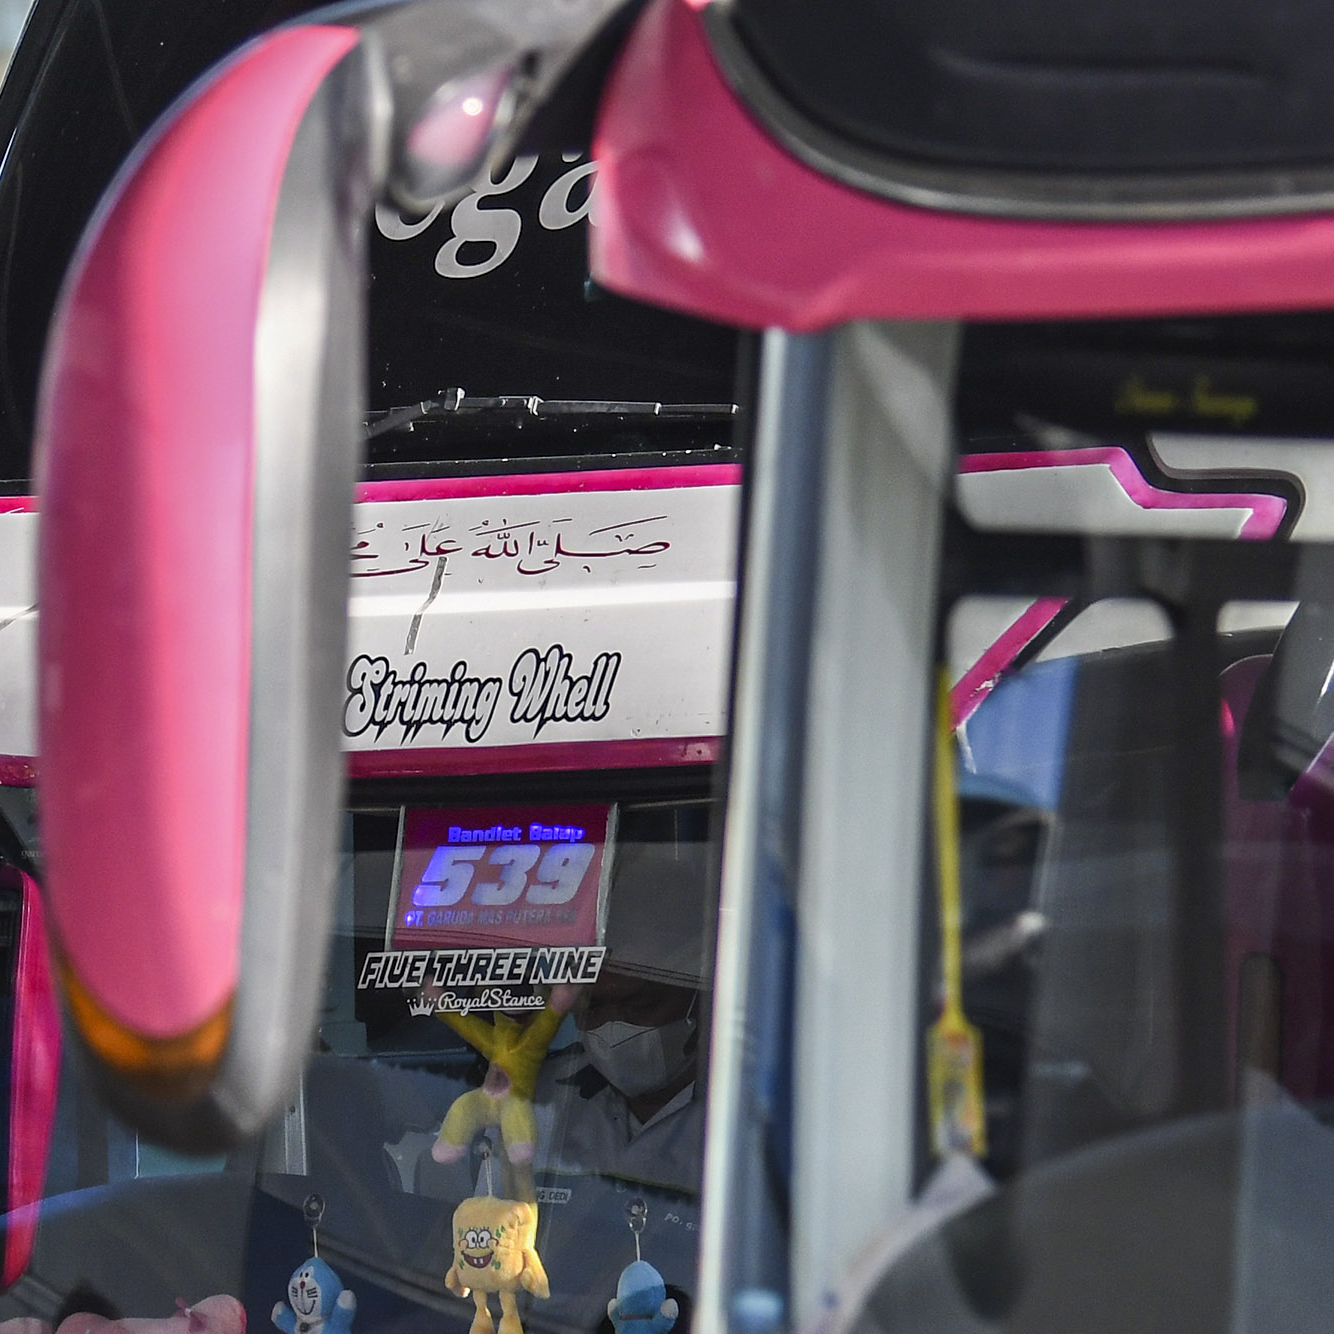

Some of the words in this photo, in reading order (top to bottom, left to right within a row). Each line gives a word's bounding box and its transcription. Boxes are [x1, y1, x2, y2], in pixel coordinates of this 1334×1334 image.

[508, 644, 622, 740] Whell
[412, 844, 595, 907] 539
[430, 947, 534, 986] THREE
[528, 946, 607, 985] NINE
